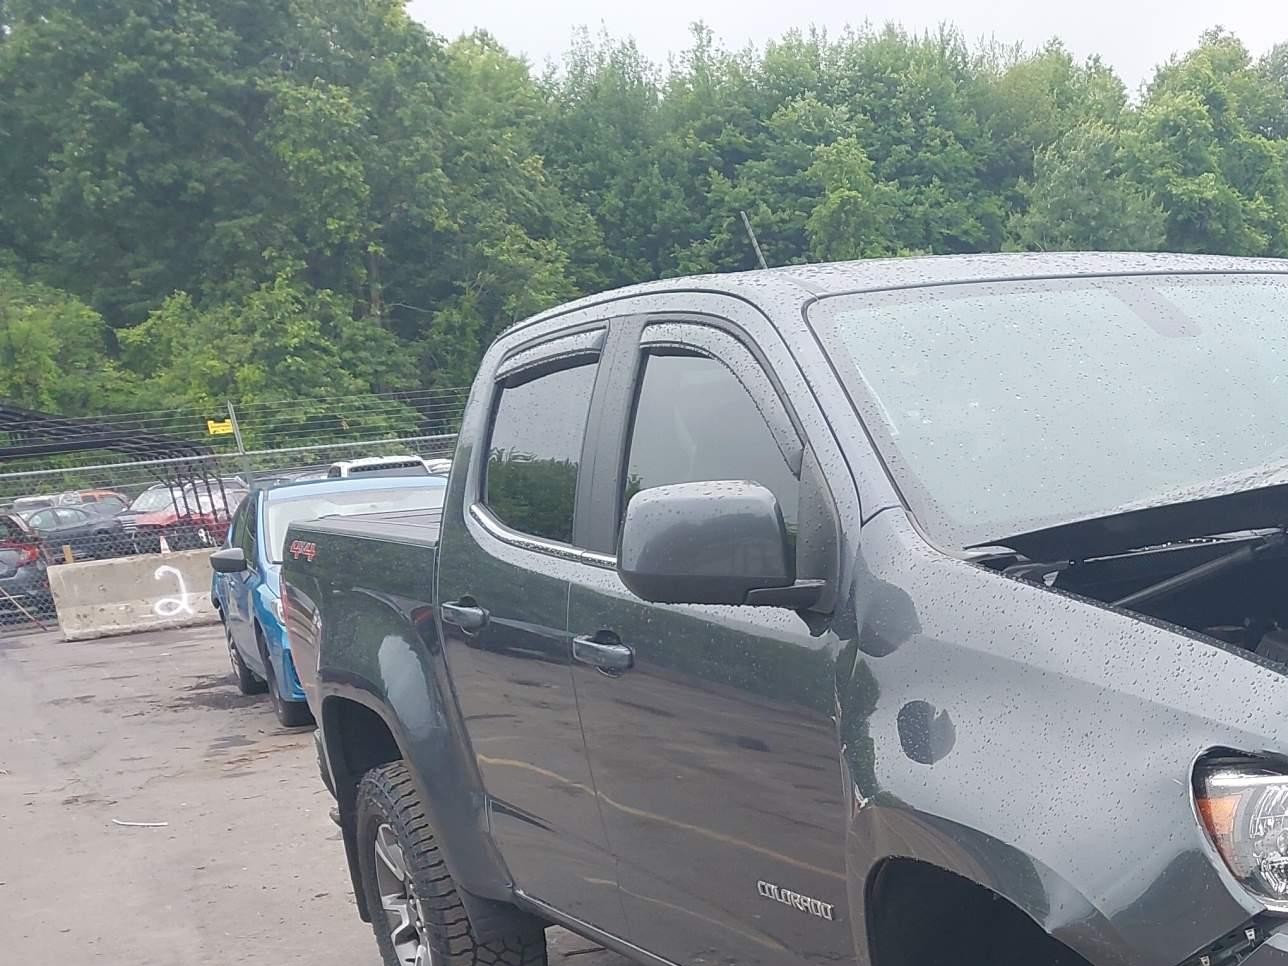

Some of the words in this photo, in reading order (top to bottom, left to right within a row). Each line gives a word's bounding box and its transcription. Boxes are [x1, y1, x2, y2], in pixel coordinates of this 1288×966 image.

[290, 540, 317, 561] 44
[154, 564, 194, 616] 2
[757, 880, 834, 920] COLORADO
